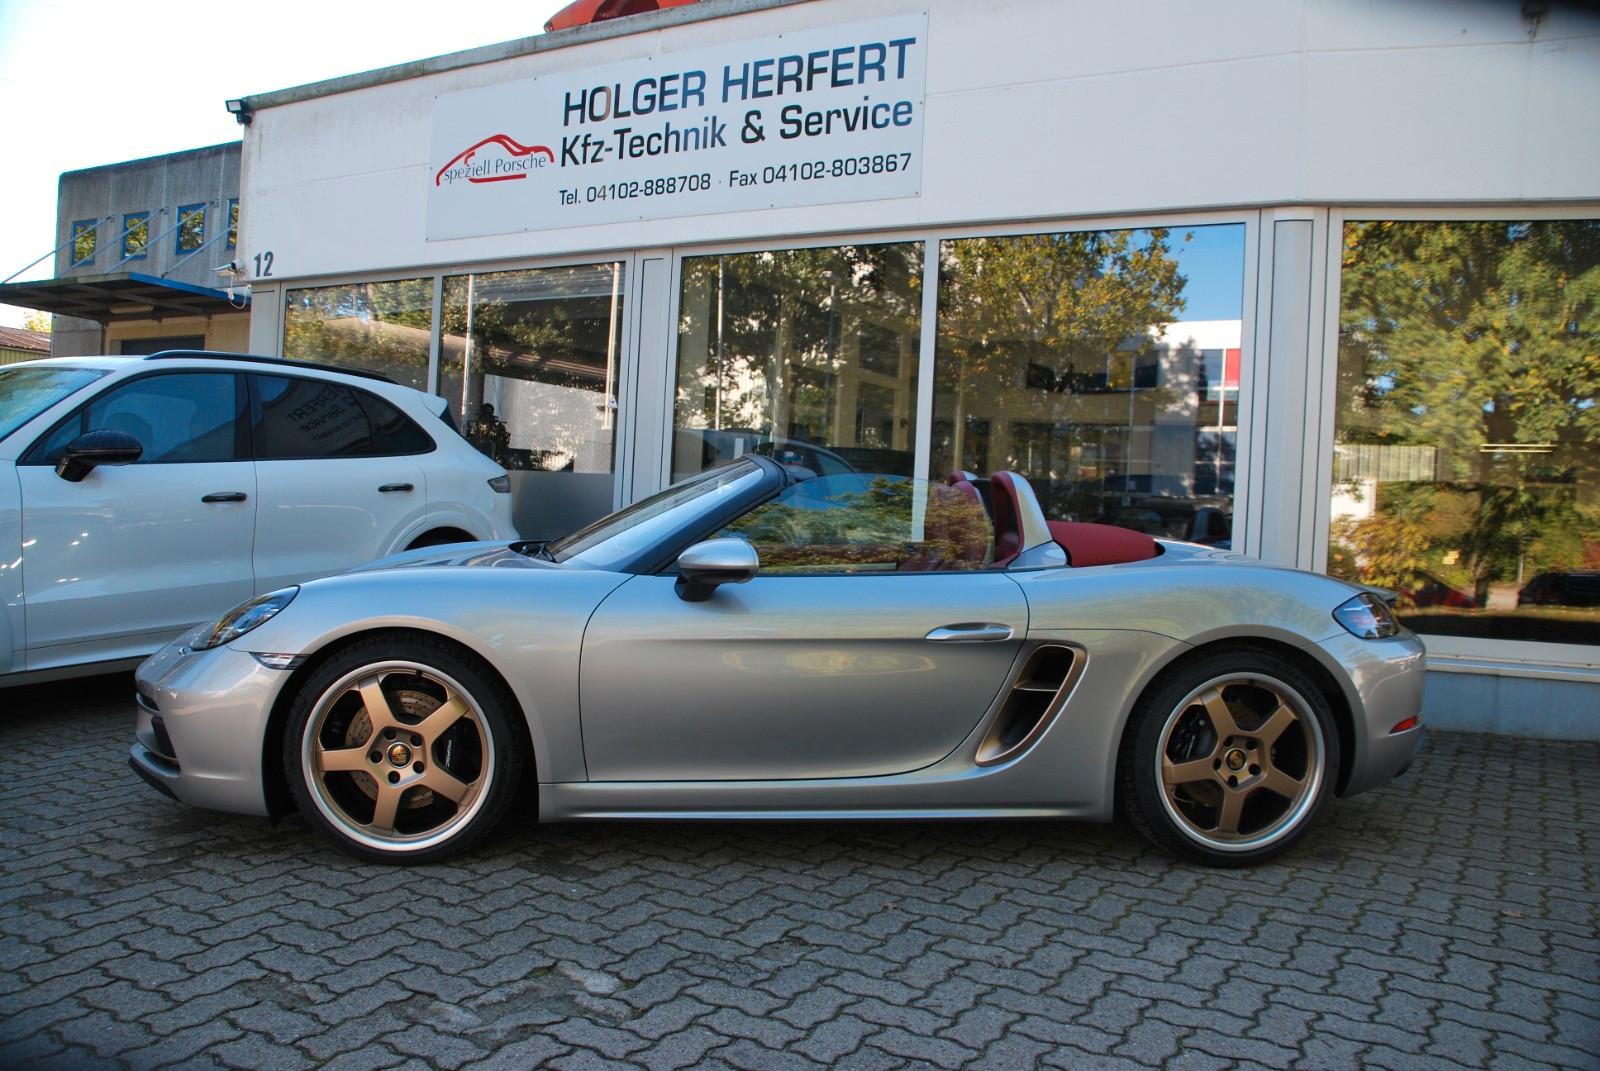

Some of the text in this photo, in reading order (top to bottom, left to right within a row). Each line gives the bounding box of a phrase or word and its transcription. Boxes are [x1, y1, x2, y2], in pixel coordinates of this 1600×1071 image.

[563, 37, 916, 126] HOLGER HERFERT
[561, 95, 913, 167] Kfz-Technik & Service
[444, 152, 547, 184] speziell Porsche
[559, 152, 912, 205] Tel. 04102-888708 Fax 04102-803867
[254, 251, 274, 277] 12
